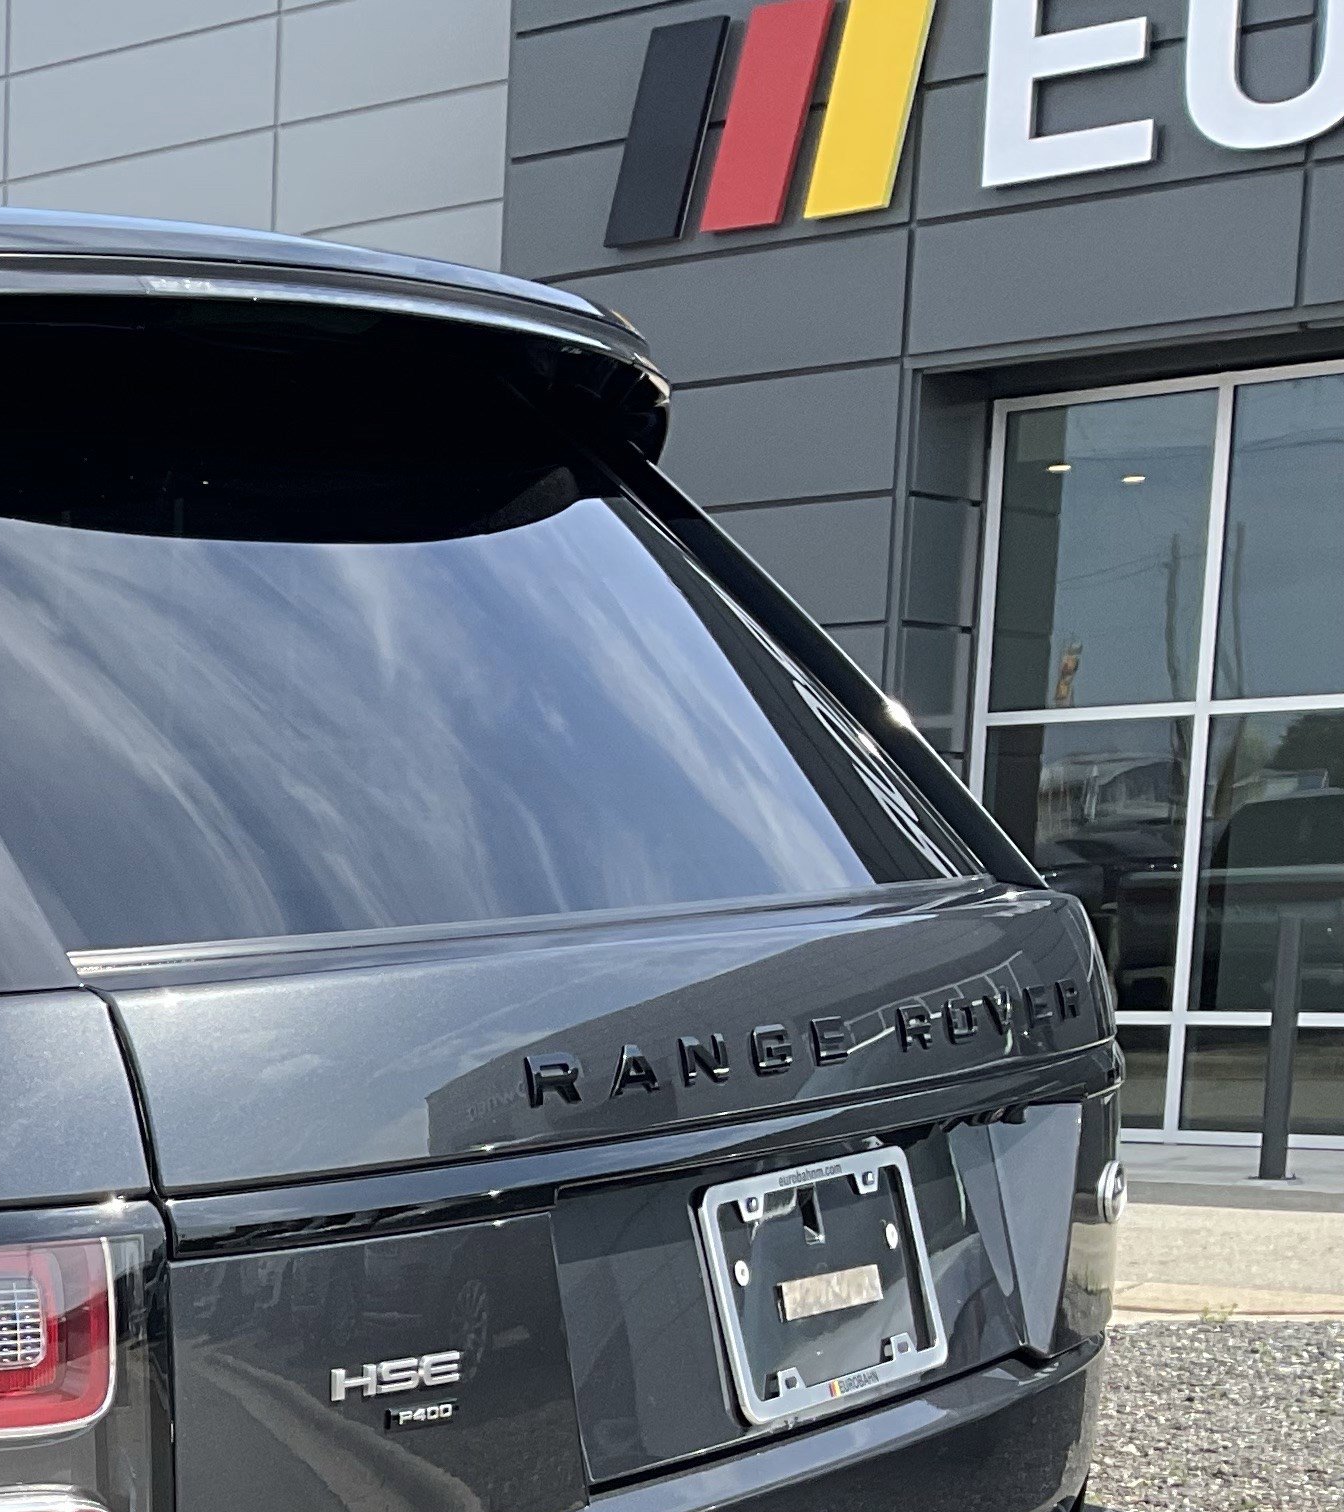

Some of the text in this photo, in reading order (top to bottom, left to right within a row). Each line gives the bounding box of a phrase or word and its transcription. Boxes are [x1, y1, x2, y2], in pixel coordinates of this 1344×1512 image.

[524, 1016, 854, 1108] RANGE
[895, 979, 1080, 1052] ROVER
[778, 1163, 843, 1188] eurobahnm.com
[331, 1350, 461, 1402] HSE
[838, 1369, 880, 1394] EUROBAHN
[398, 1403, 453, 1426] P400
